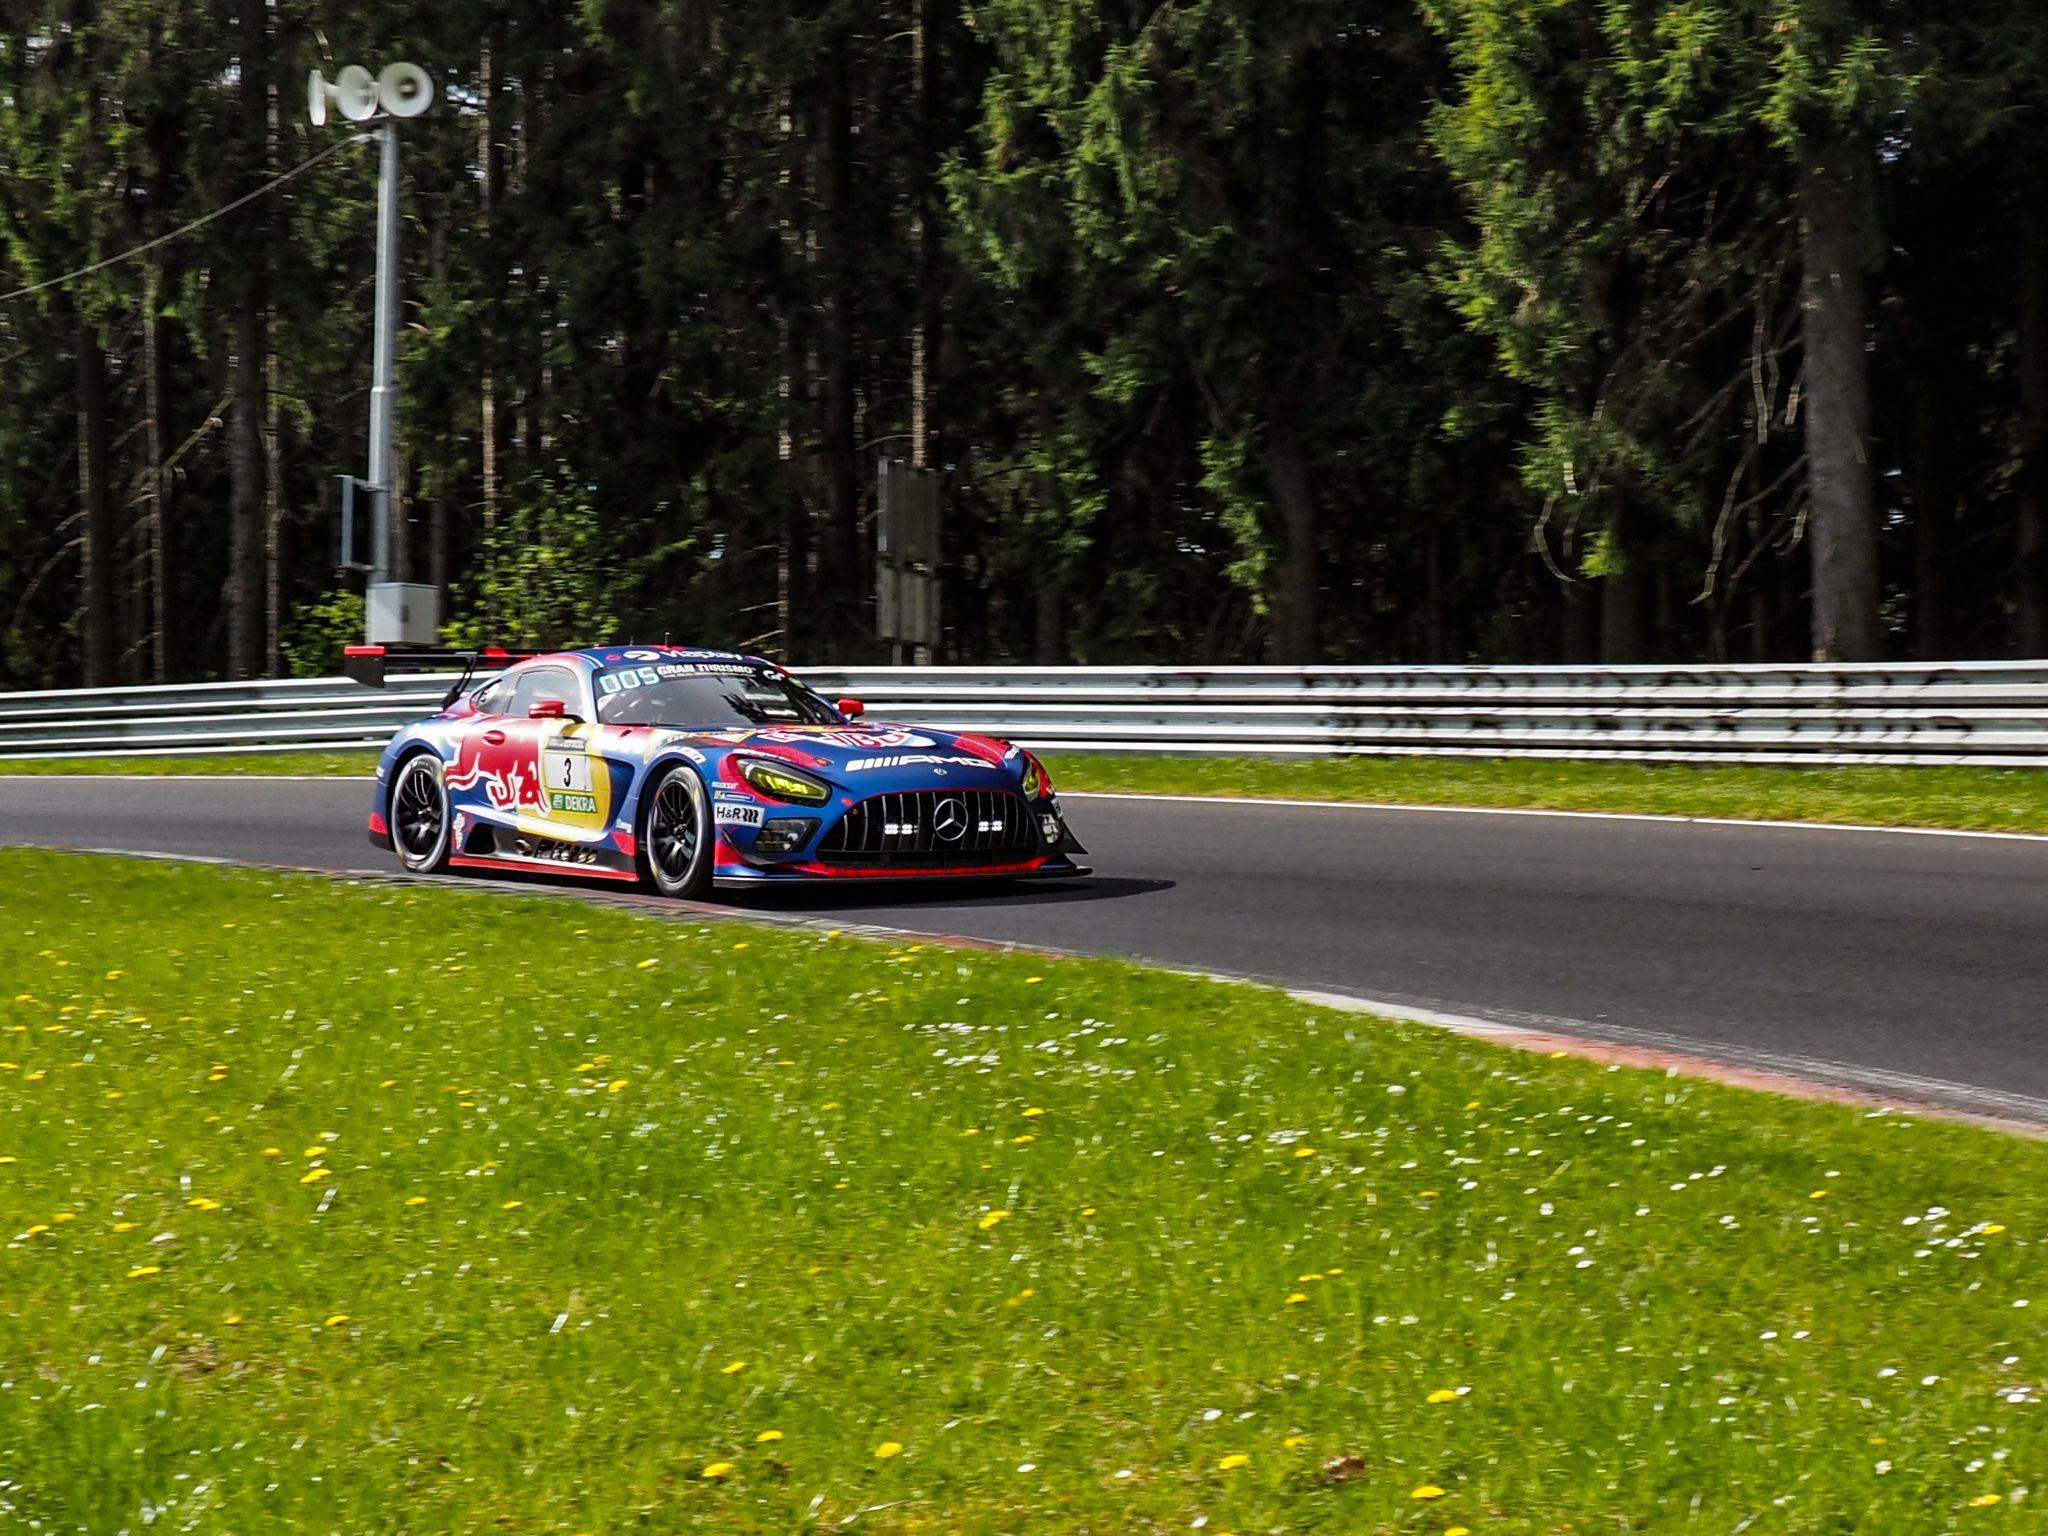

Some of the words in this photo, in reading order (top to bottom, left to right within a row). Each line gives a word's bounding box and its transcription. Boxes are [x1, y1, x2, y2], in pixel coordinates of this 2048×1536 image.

[657, 664, 695, 675] GRAN
[695, 663, 754, 674] TURISMO
[899, 755, 997, 769] AMG
[563, 757, 572, 787] 3
[565, 795, 597, 812] DEKRA
[716, 806, 741, 820] H&R
